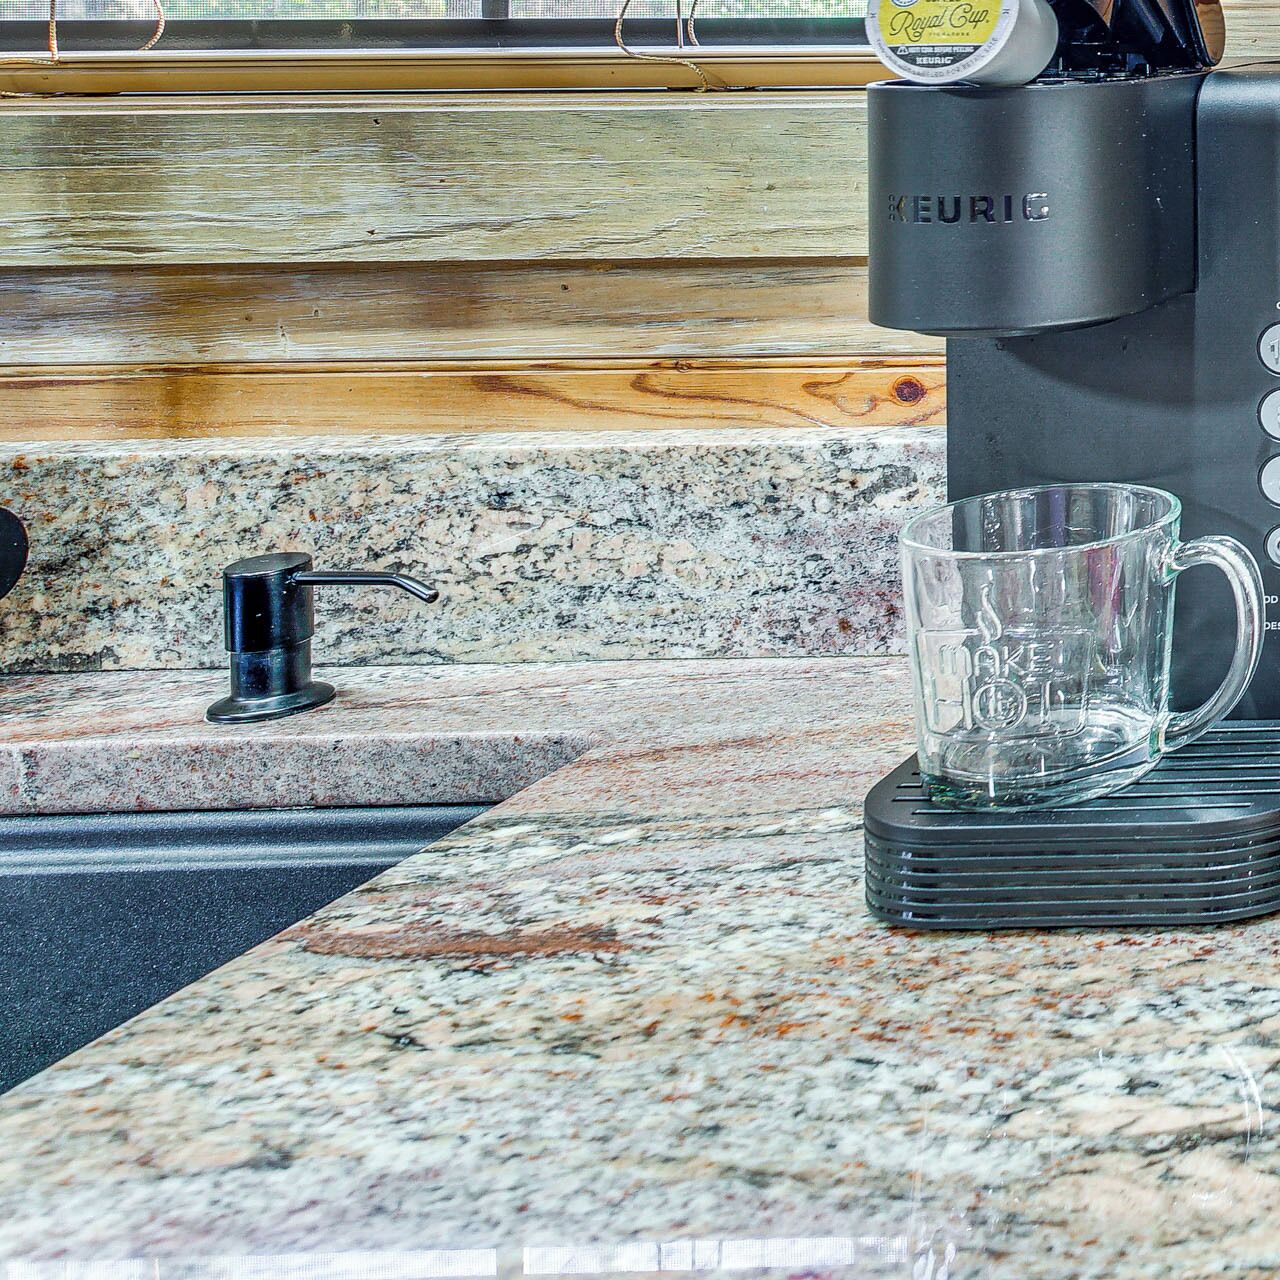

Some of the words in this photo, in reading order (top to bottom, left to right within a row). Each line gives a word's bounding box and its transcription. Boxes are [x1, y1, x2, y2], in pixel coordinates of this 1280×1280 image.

[889, 6, 948, 43] Royal
[915, 56, 954, 65] KEURIG
[888, 193, 1049, 224] KEURIG
